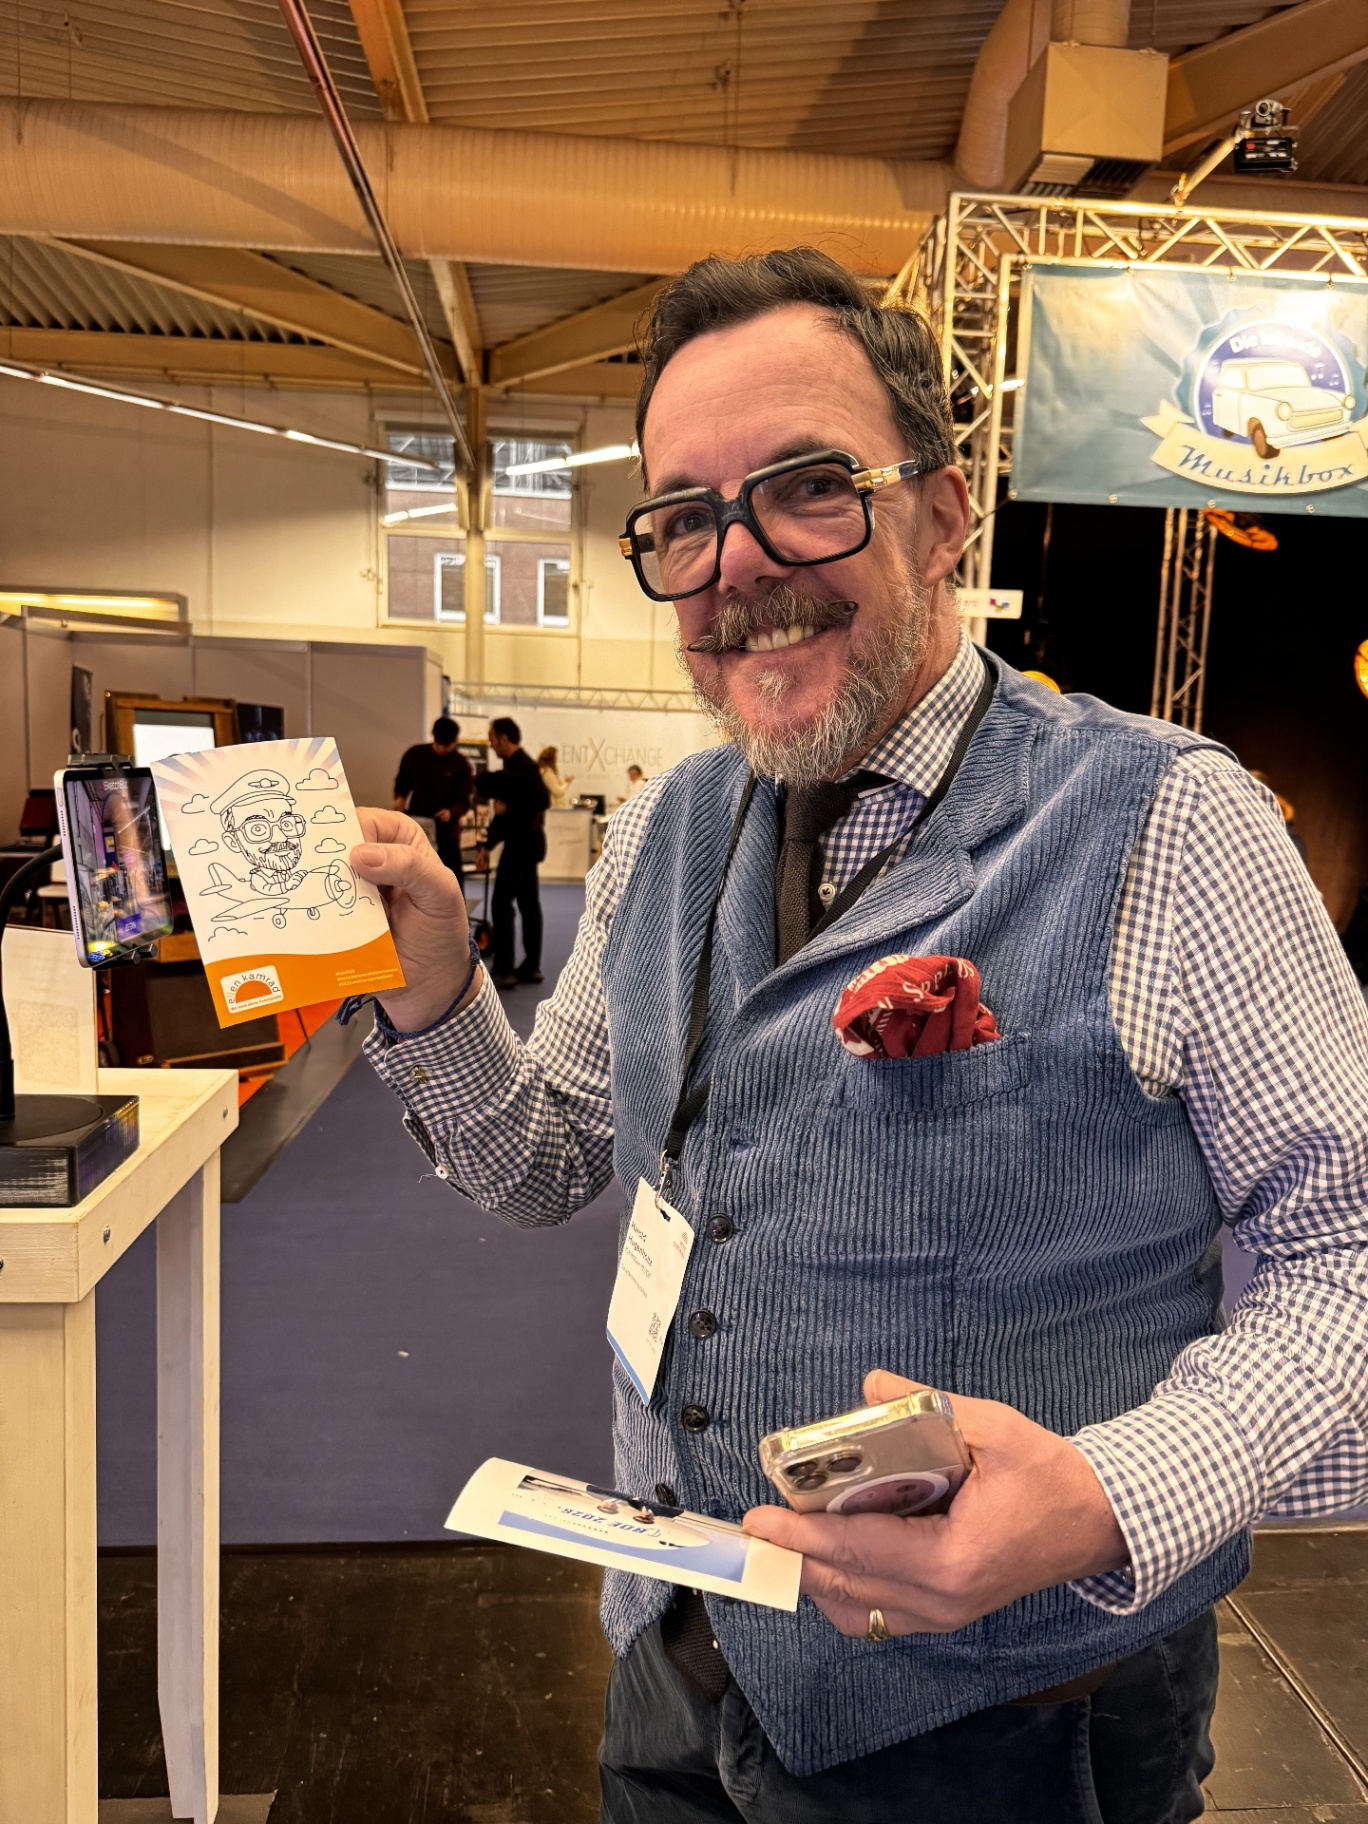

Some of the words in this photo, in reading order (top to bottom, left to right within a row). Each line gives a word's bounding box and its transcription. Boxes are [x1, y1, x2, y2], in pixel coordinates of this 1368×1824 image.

[1178, 444, 1354, 487] Musikbox
[228, 980, 242, 1004] ellen
[241, 973, 281, 993] kamrad
